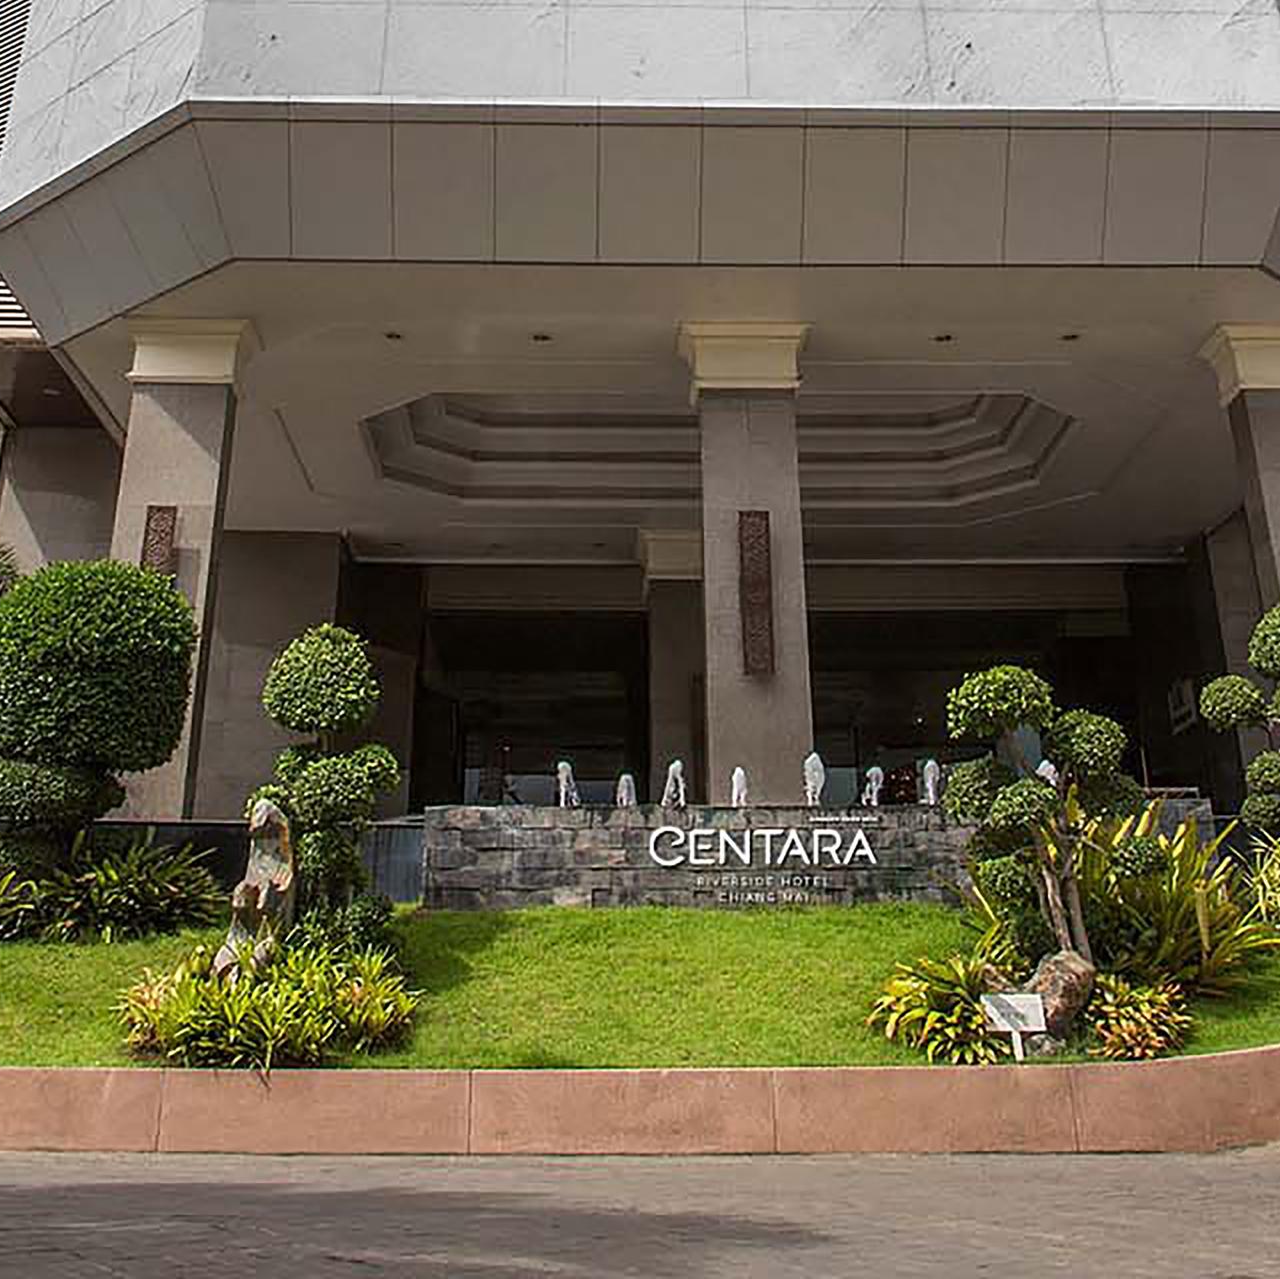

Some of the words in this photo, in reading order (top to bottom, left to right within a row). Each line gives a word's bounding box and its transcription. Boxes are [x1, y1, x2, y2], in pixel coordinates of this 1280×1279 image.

[649, 826, 878, 866] CENTARA
[696, 875, 774, 887] RIVERSIDE
[781, 875, 829, 887] HOTEL
